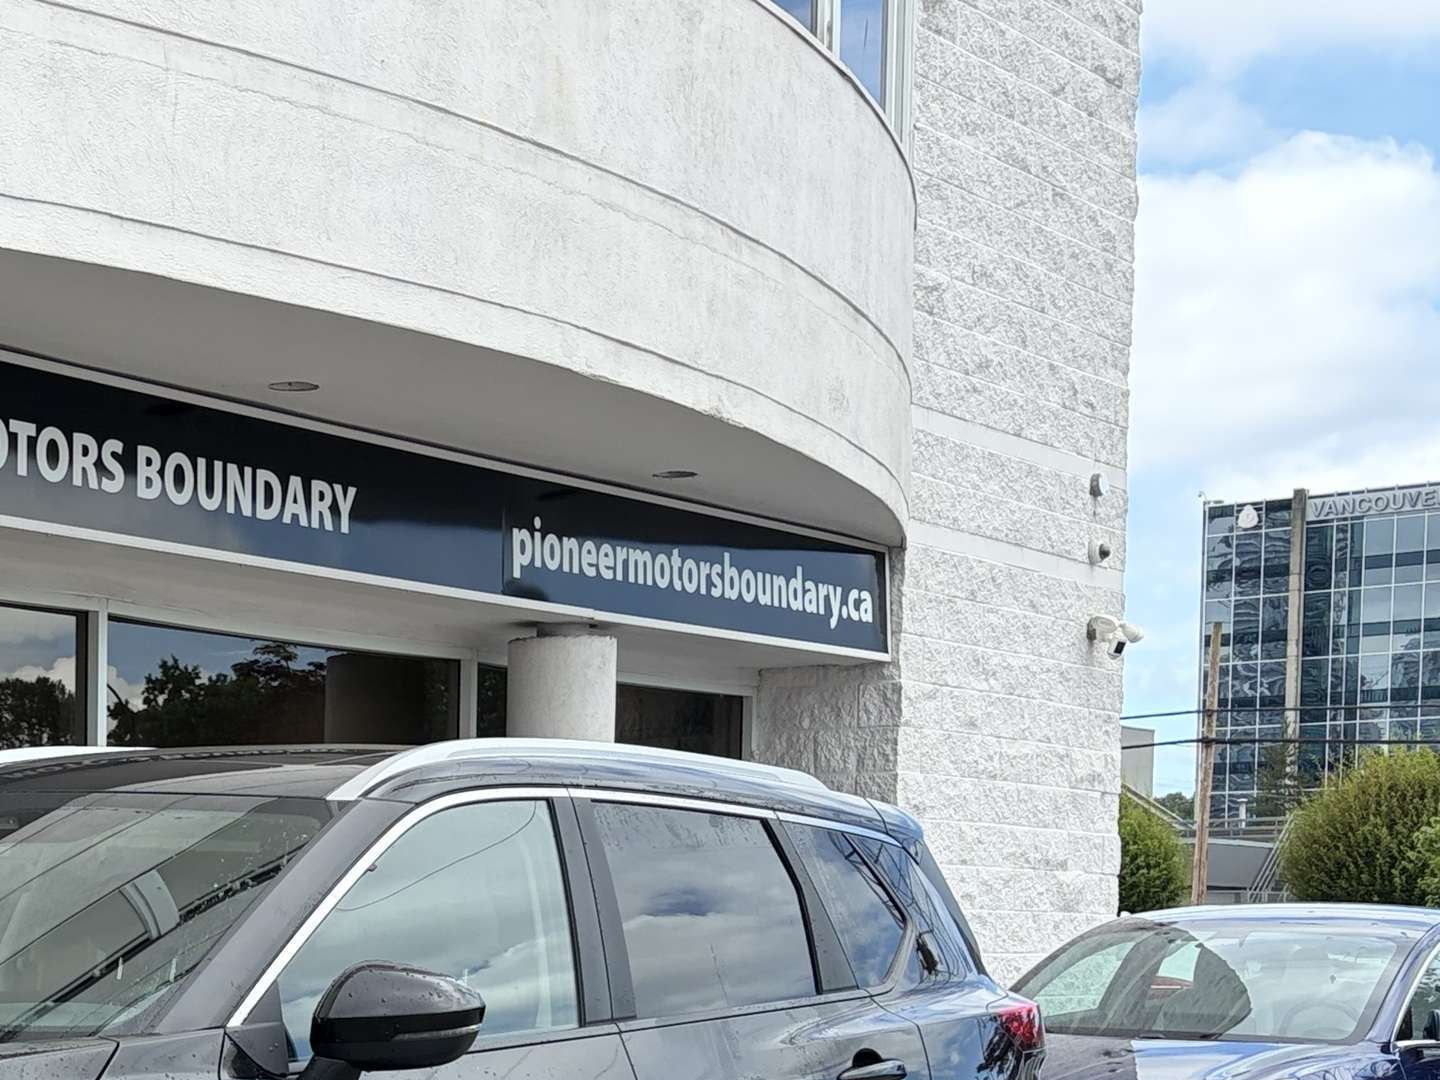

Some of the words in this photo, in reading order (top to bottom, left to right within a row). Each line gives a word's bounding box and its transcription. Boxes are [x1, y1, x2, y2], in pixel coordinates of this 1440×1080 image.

[137, 443, 357, 534] BOUNDARY
[1311, 489, 1440, 518] VANCOUVE
[512, 515, 873, 630] pioneermotorsboundary.ca
